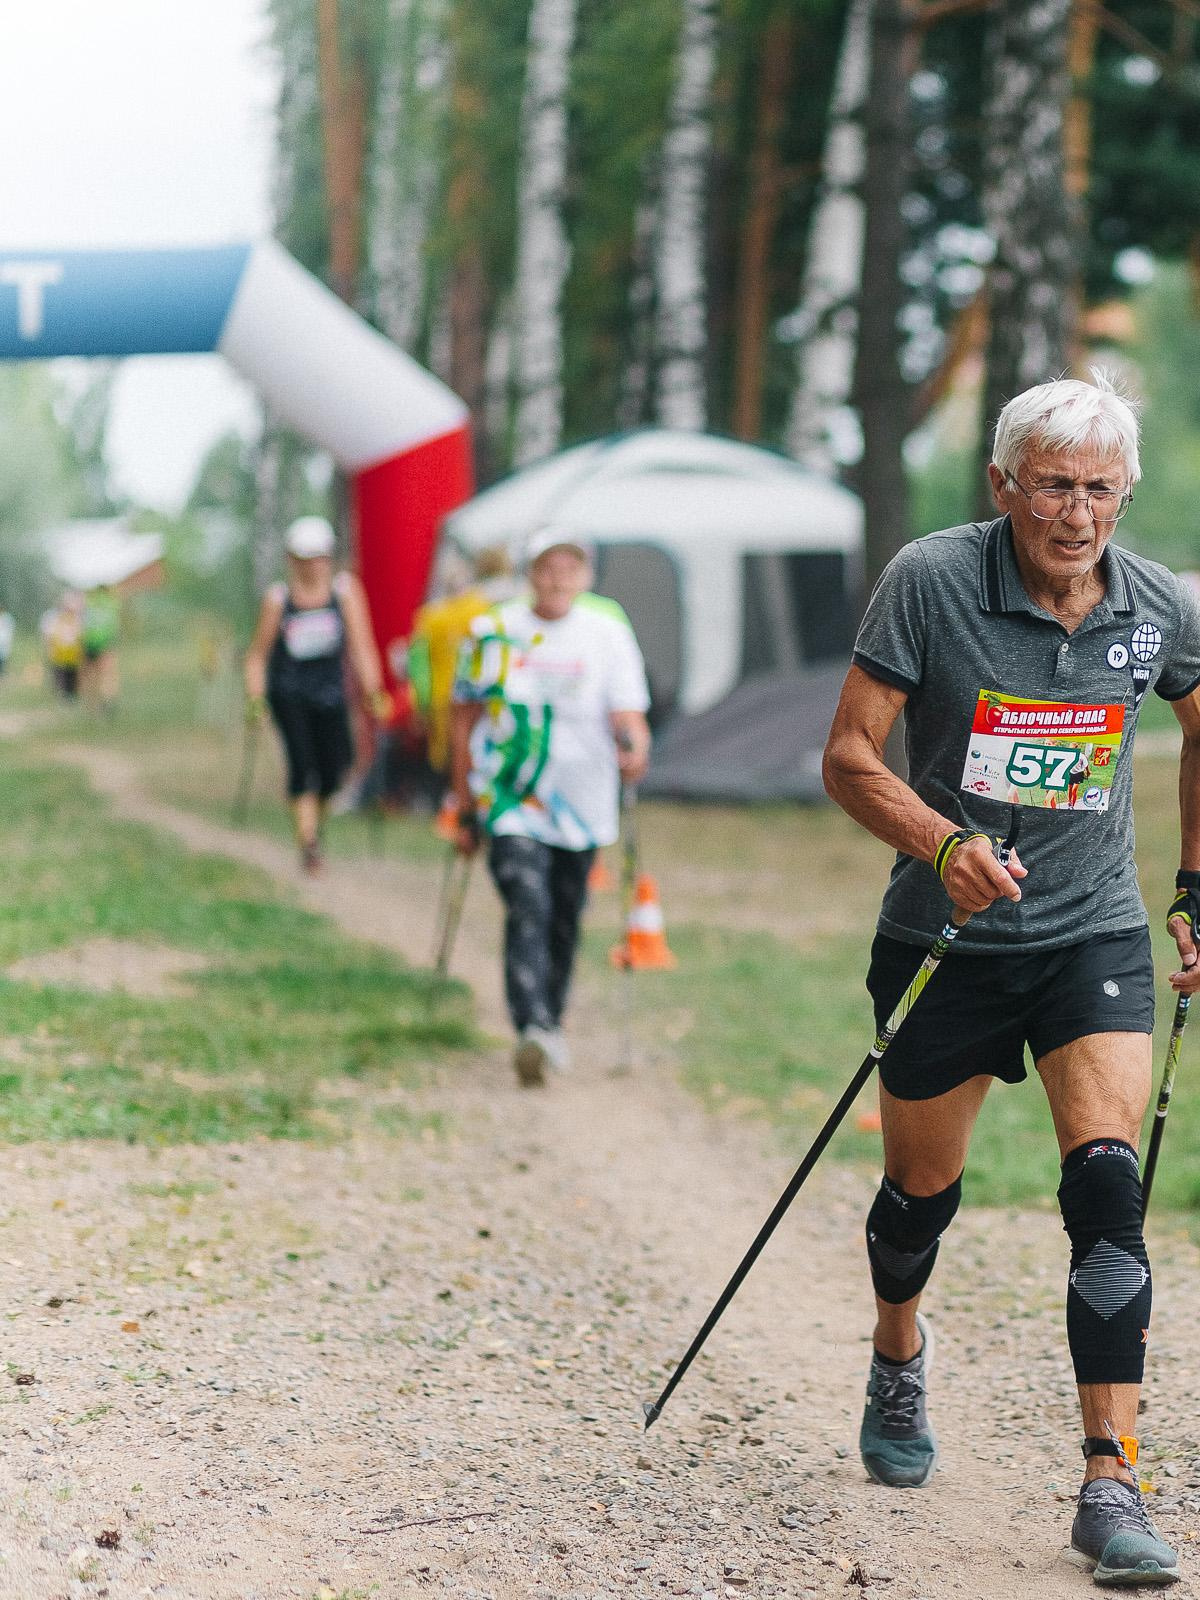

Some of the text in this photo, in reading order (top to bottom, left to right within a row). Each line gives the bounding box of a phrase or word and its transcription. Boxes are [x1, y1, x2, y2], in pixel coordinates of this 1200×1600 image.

[1113, 650, 1123, 662] 19
[1000, 708, 1107, 725] ЯБЛОЧНЫЙ СПАС
[1008, 744, 1079, 789] 57
